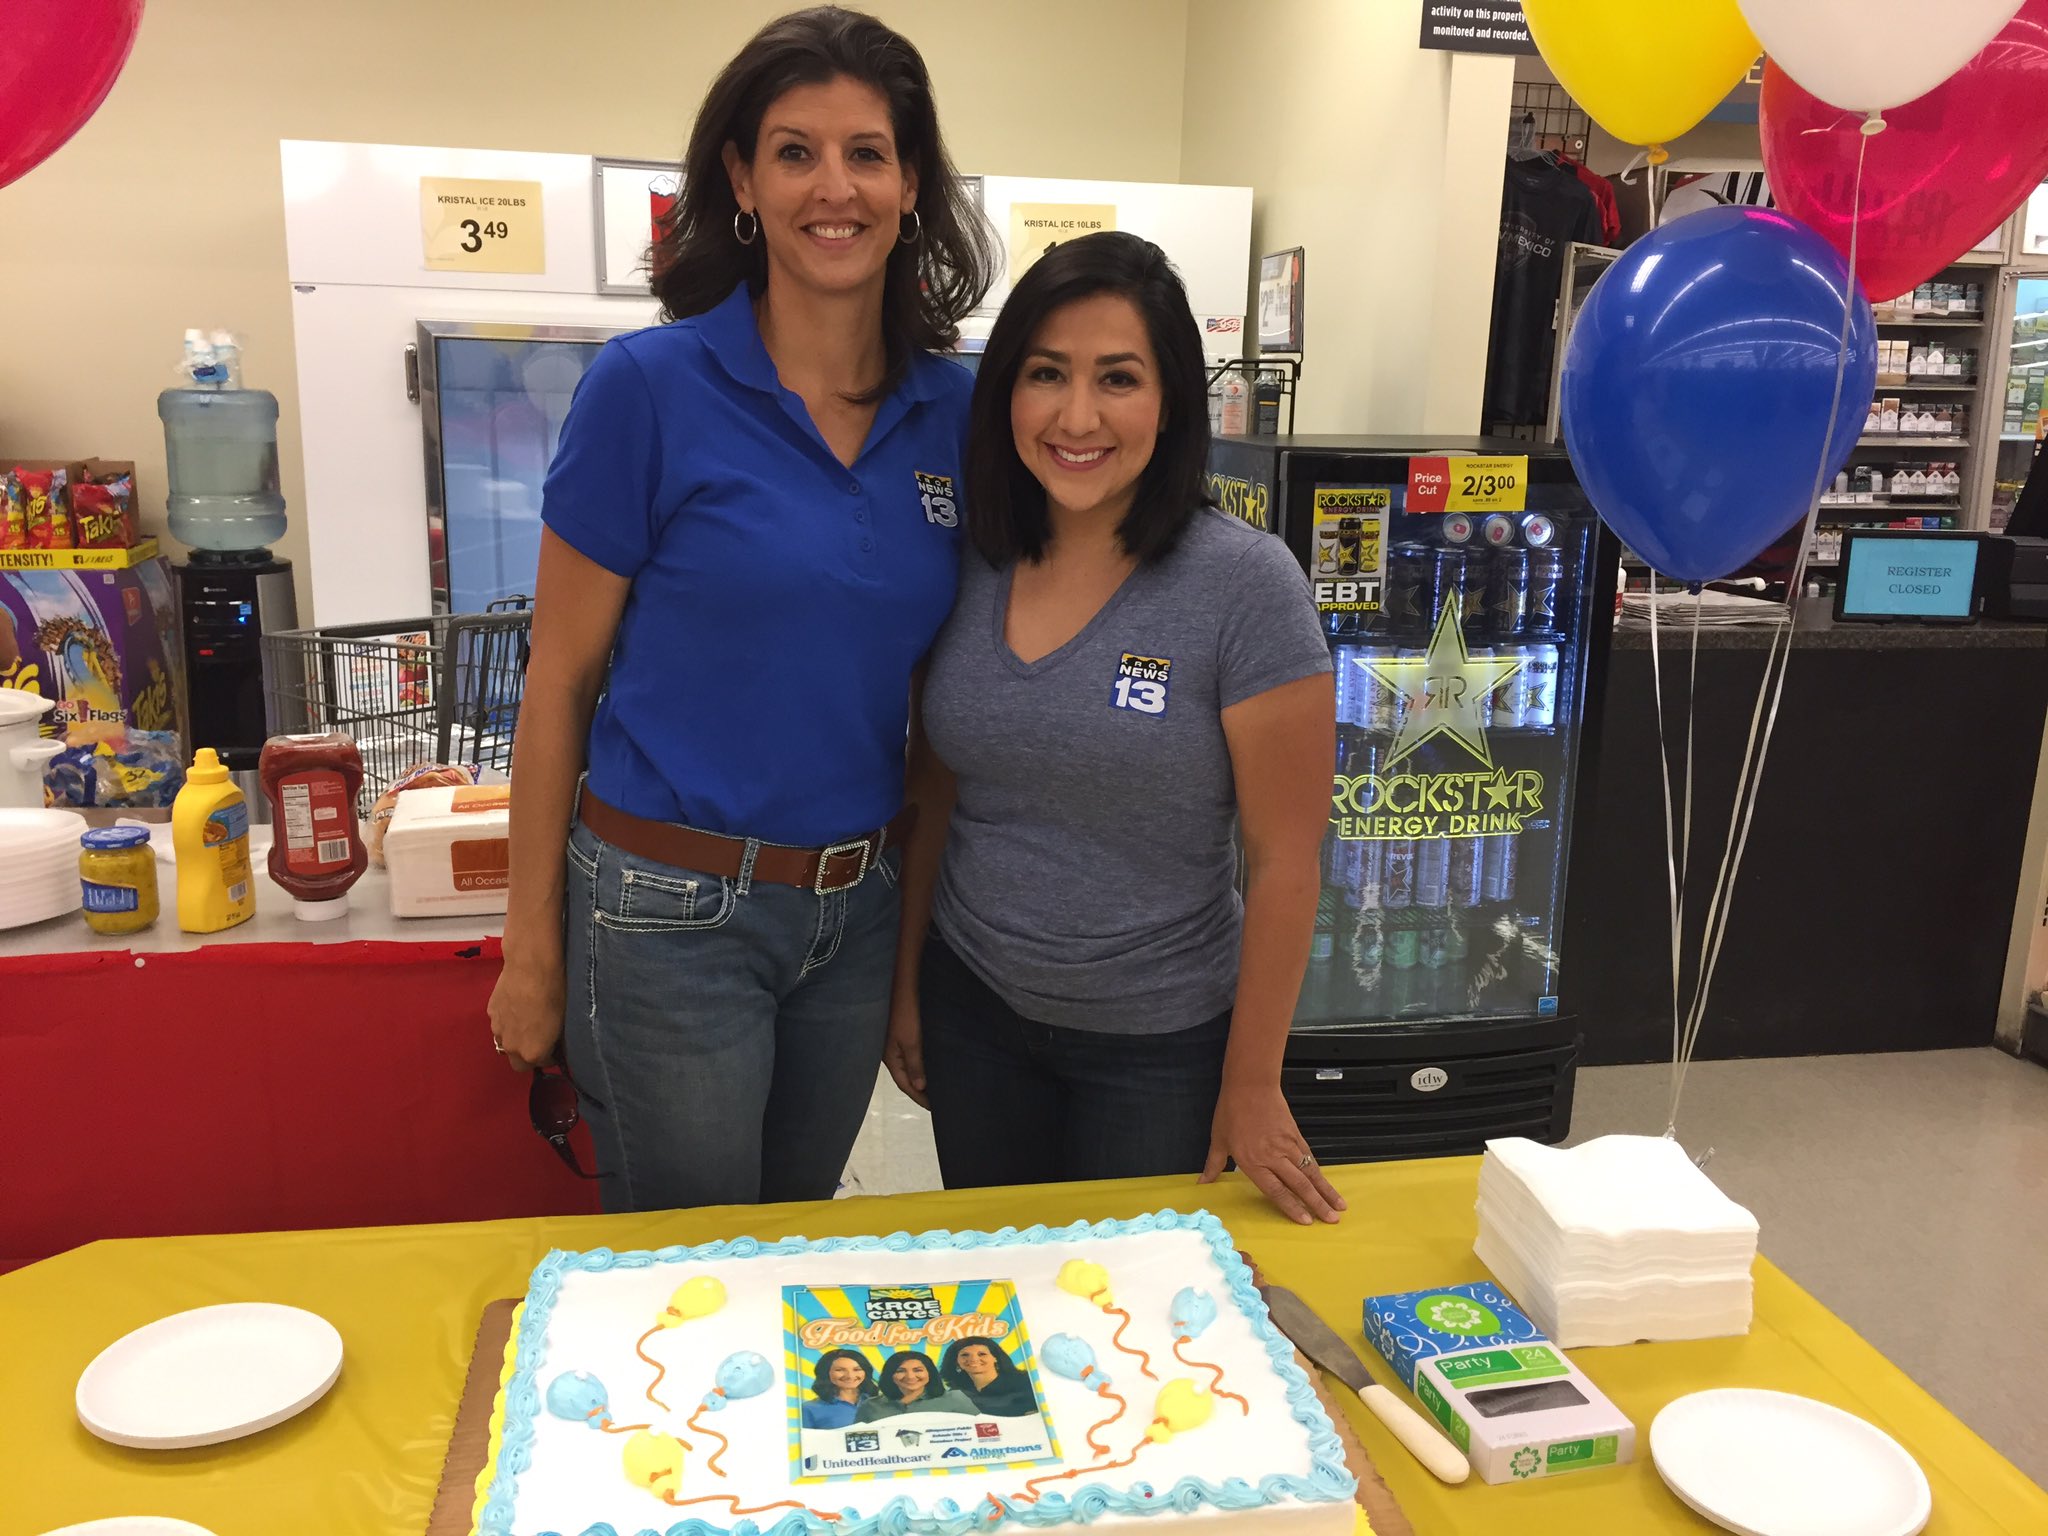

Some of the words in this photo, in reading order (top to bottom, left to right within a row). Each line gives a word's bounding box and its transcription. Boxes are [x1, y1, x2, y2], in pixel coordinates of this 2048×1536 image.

[1431, 6, 1462, 19] activity
[1463, 8, 1474, 18] on
[1475, 8, 1491, 19] this
[1492, 11, 1526, 23] property
[1433, 25, 1474, 37] monitored
[1475, 28, 1491, 38] and
[1492, 30, 1530, 41] recorded.
[437, 195, 477, 205] KRISTAL
[479, 197, 495, 206] ICE
[497, 198, 527, 207] 20LBS
[1024, 219, 1059, 228] KRISTAL
[1060, 220, 1075, 229] ICE
[1077, 221, 1102, 229] 10LBS
[1414, 473, 1442, 483] Price
[917, 481, 954, 497] NEWS
[1418, 485, 1437, 495] Cut
[1318, 494, 1386, 507] ROCKSTAR
[920, 493, 959, 528] 13
[1887, 566, 1952, 577] REGISTER
[1314, 581, 1380, 603] EBT
[1888, 583, 1942, 595] CLOSED
[1119, 664, 1168, 682] NEWS
[1114, 676, 1167, 714] 13
[54, 710, 78, 722] Six
[89, 709, 126, 723] Flags
[1332, 772, 1543, 814] ROCKSTAR
[1340, 815, 1440, 836] ENERGY
[1449, 812, 1522, 834] DRINK
[460, 877, 473, 887] All
[865, 1299, 940, 1311] KRQE
[867, 1309, 942, 1321] cares
[803, 1319, 884, 1347] Food
[886, 1323, 923, 1345] for
[927, 1315, 1006, 1343] Kids
[1439, 1357, 1491, 1373] Party
[1521, 1348, 1547, 1361] 24
[1418, 1373, 1442, 1412] Party
[848, 1440, 879, 1451] 13
[969, 1443, 1042, 1457] Albertsons
[1548, 1445, 1580, 1457] Party
[822, 1454, 931, 1469] UnitedHealthcare
